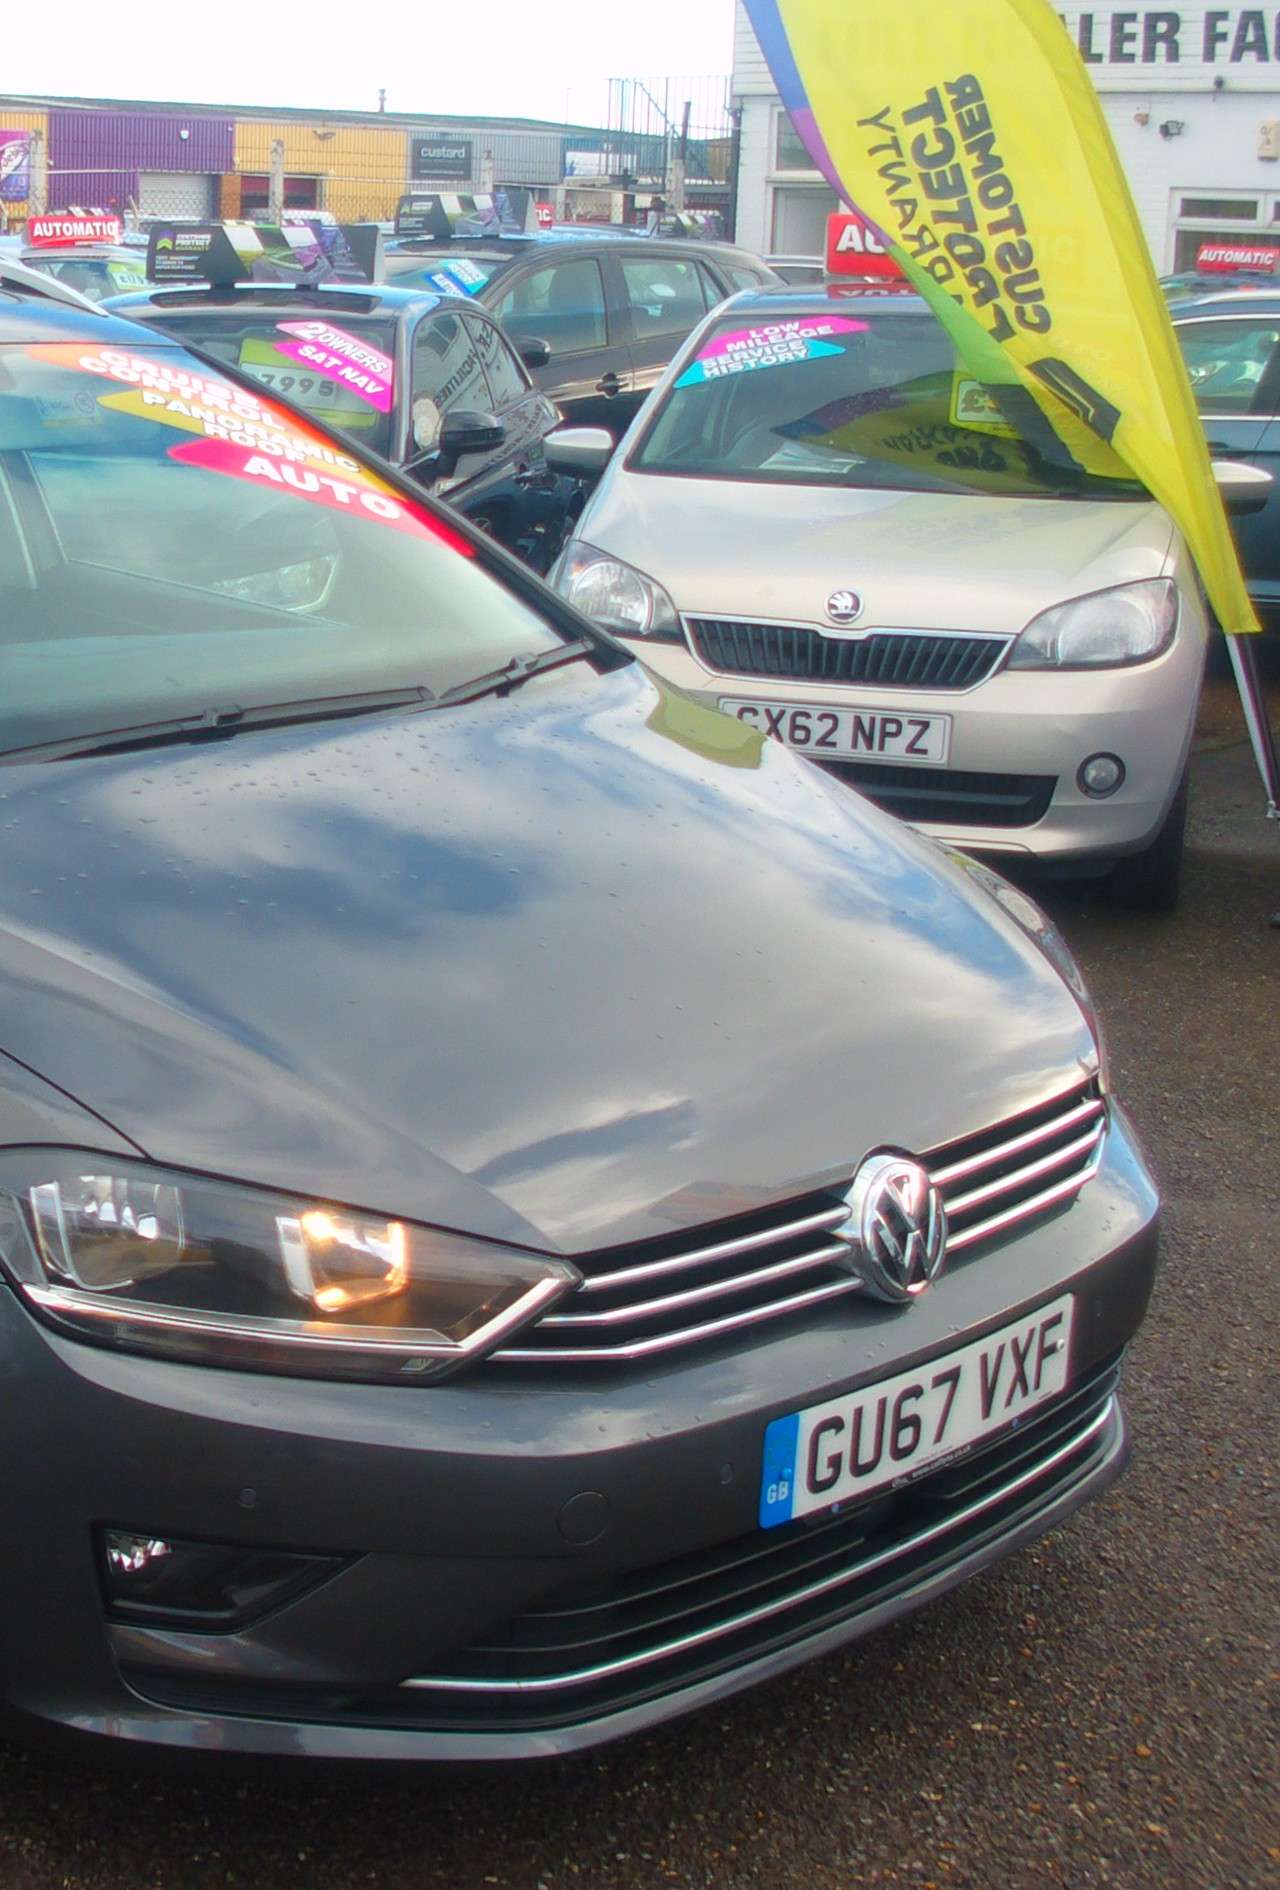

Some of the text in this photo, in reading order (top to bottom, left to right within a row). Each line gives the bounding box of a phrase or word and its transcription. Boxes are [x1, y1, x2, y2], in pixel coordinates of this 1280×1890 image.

[1059, 10, 1280, 64] LER FA
[420, 145, 465, 158] custard
[33, 220, 119, 238] AUTOMATIC
[1199, 249, 1274, 265] AUTOMATIC
[725, 325, 834, 352] MILEAGE
[750, 322, 800, 338] LOW
[297, 345, 384, 394] SAT NAV
[702, 339, 806, 369] SERVICE
[703, 349, 809, 378] HISTORY
[79, 356, 285, 431] CONTROL
[99, 350, 261, 410] CRUISE
[142, 390, 361, 473] PANORAMIC
[204, 420, 306, 462] ROOF
[243, 456, 400, 519] AUTO
[850, 714, 931, 756] NPZ
[806, 1311, 1064, 1495] GU67 VXF
[766, 1481, 789, 1505] GB
